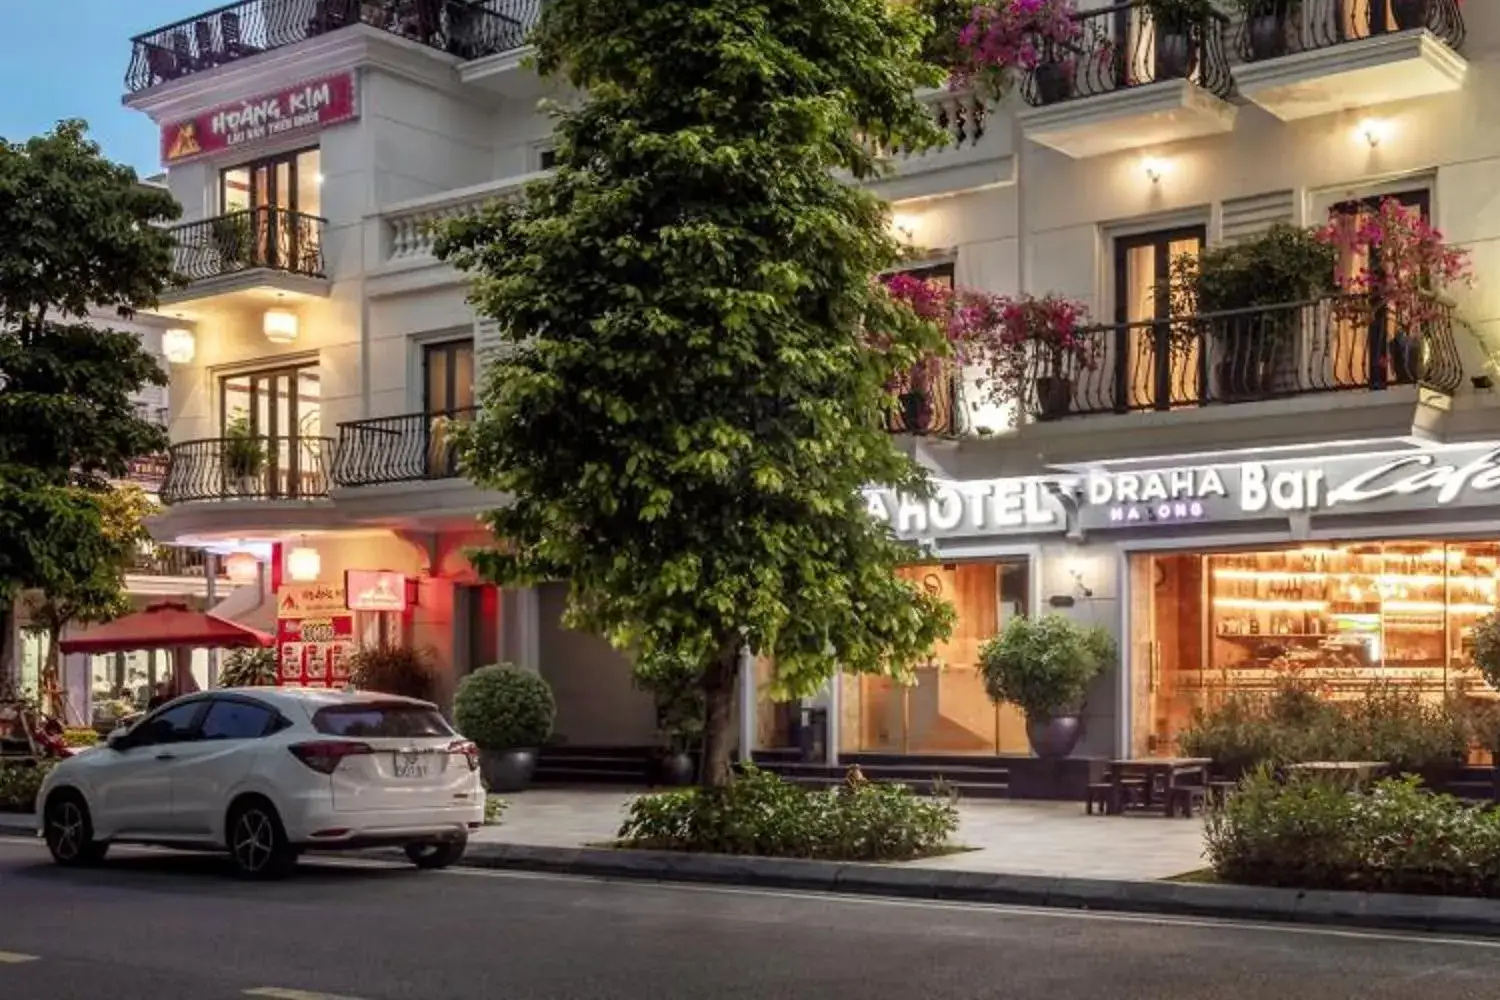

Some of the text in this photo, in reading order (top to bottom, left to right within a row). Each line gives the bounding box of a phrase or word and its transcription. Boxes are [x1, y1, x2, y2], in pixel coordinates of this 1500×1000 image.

[212, 83, 330, 134] HOÀNG KIM
[1089, 468, 1226, 504] DRAHA
[1240, 462, 1323, 512] Bar
